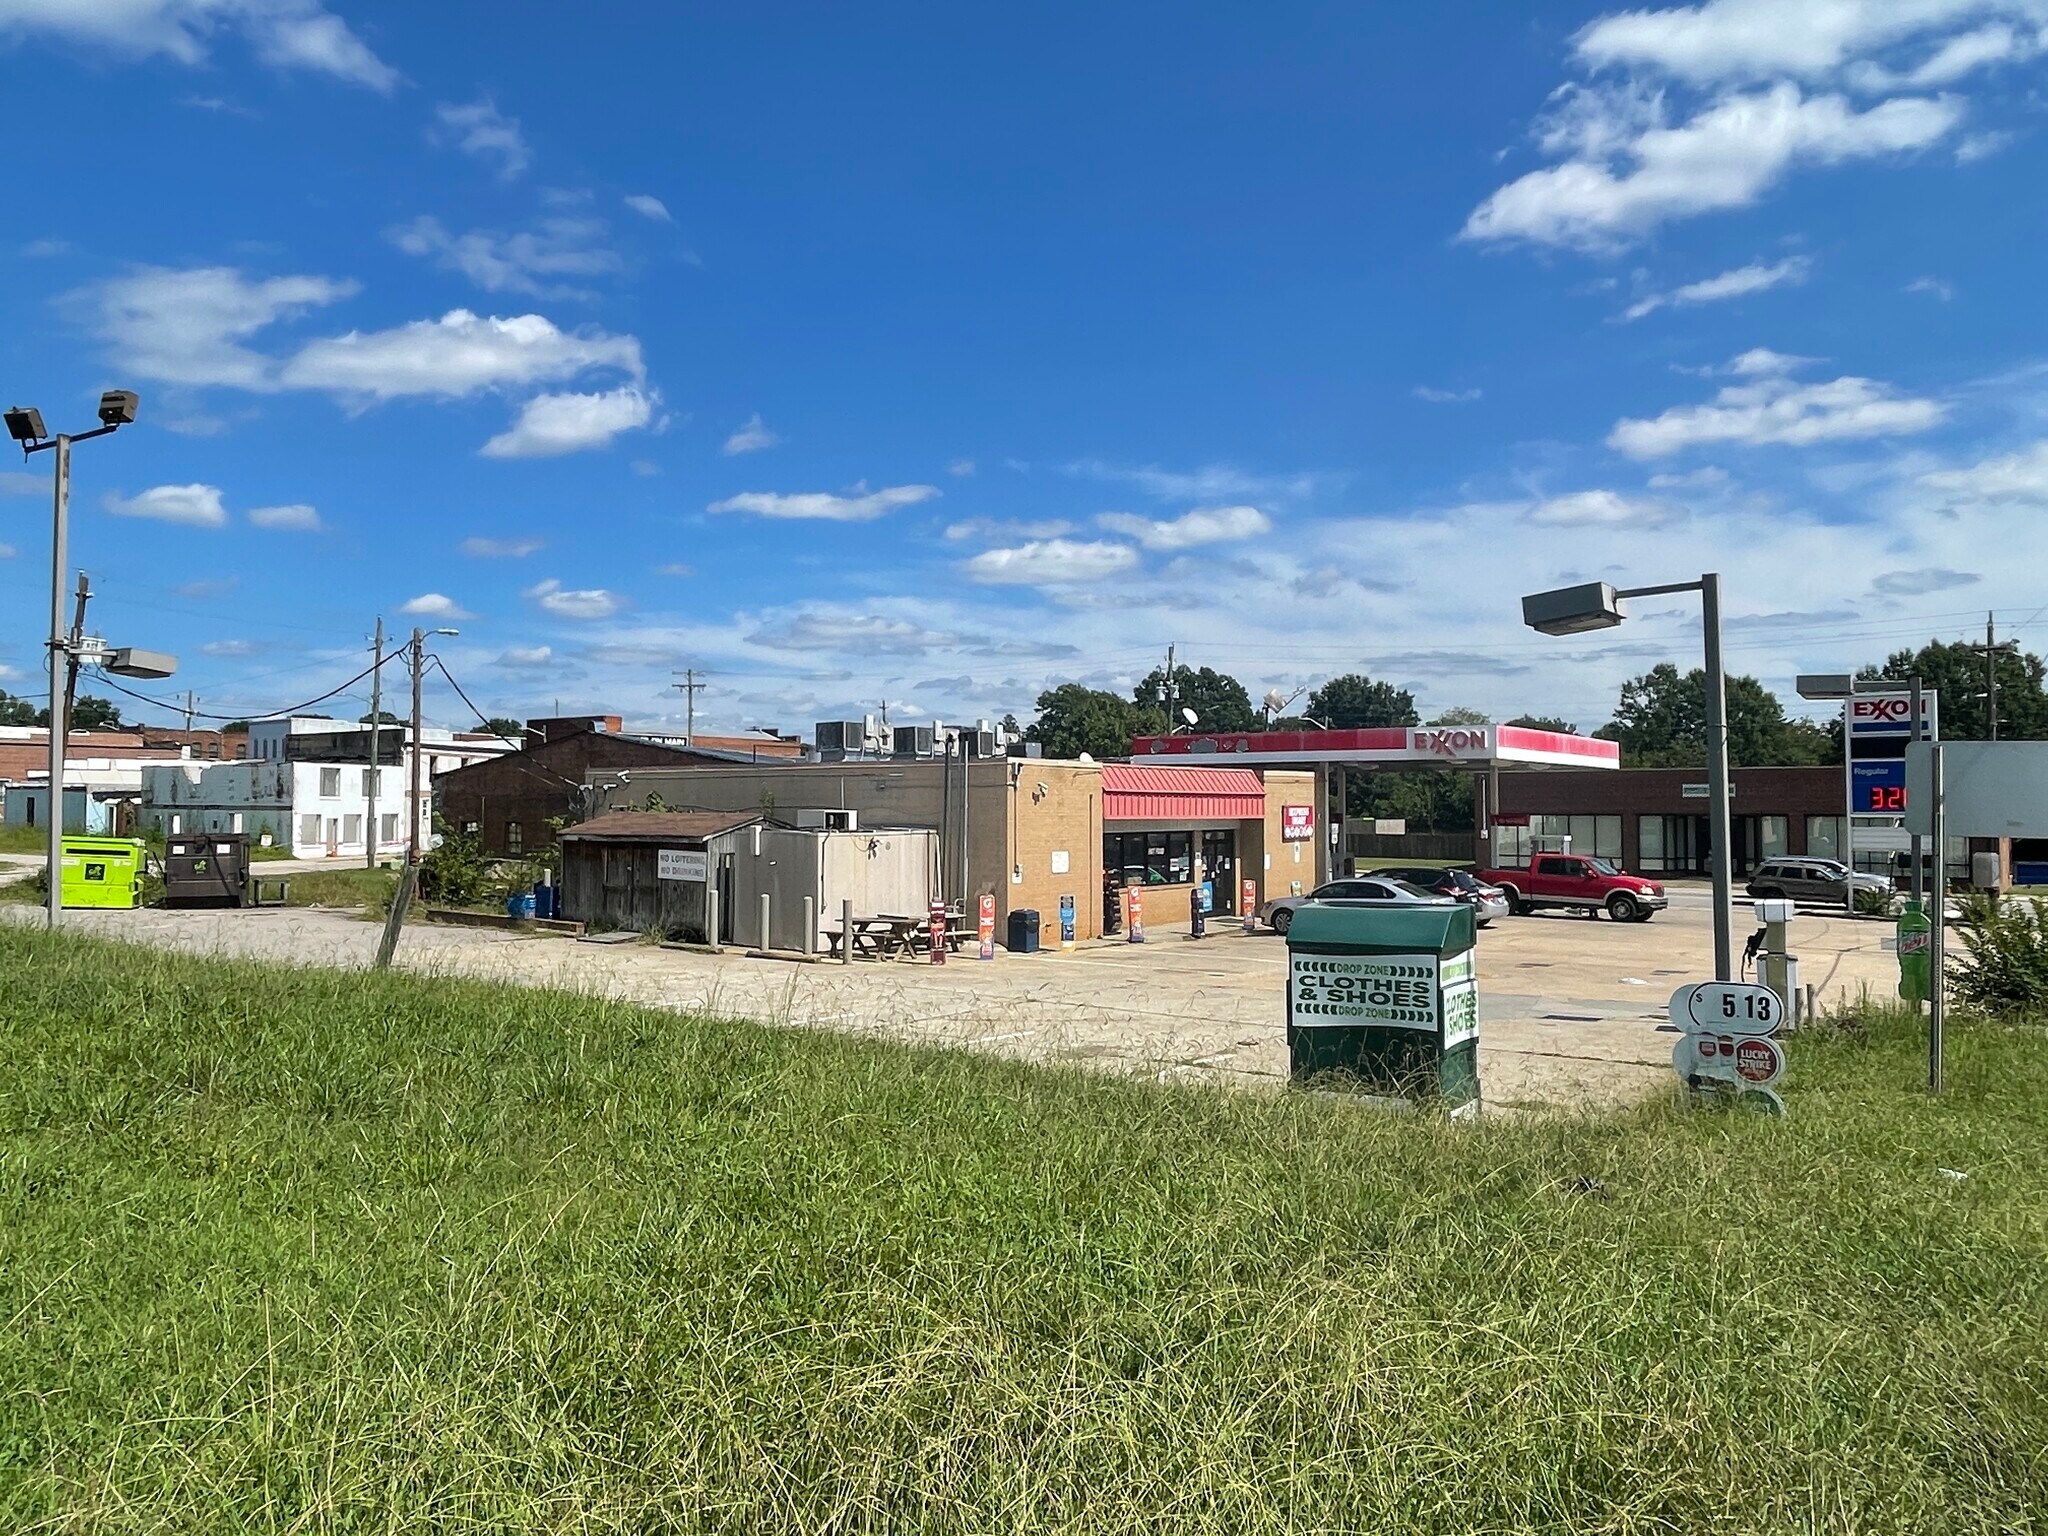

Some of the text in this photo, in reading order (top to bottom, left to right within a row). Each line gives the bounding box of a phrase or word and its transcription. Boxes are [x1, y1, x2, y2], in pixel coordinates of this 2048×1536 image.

[1854, 699, 1927, 721] EXXO
[1414, 729, 1488, 756] EXXON
[1854, 768, 1889, 776] Regular
[1337, 963, 1389, 976] DROP ZONE
[1298, 975, 1431, 994] CLOTHES
[1298, 988, 1431, 1008] & SHOES
[1339, 1006, 1391, 1019] DROP ZONE
[1741, 1049, 1770, 1060] LUCKY
[1740, 1060, 1772, 1070] STRIKE
